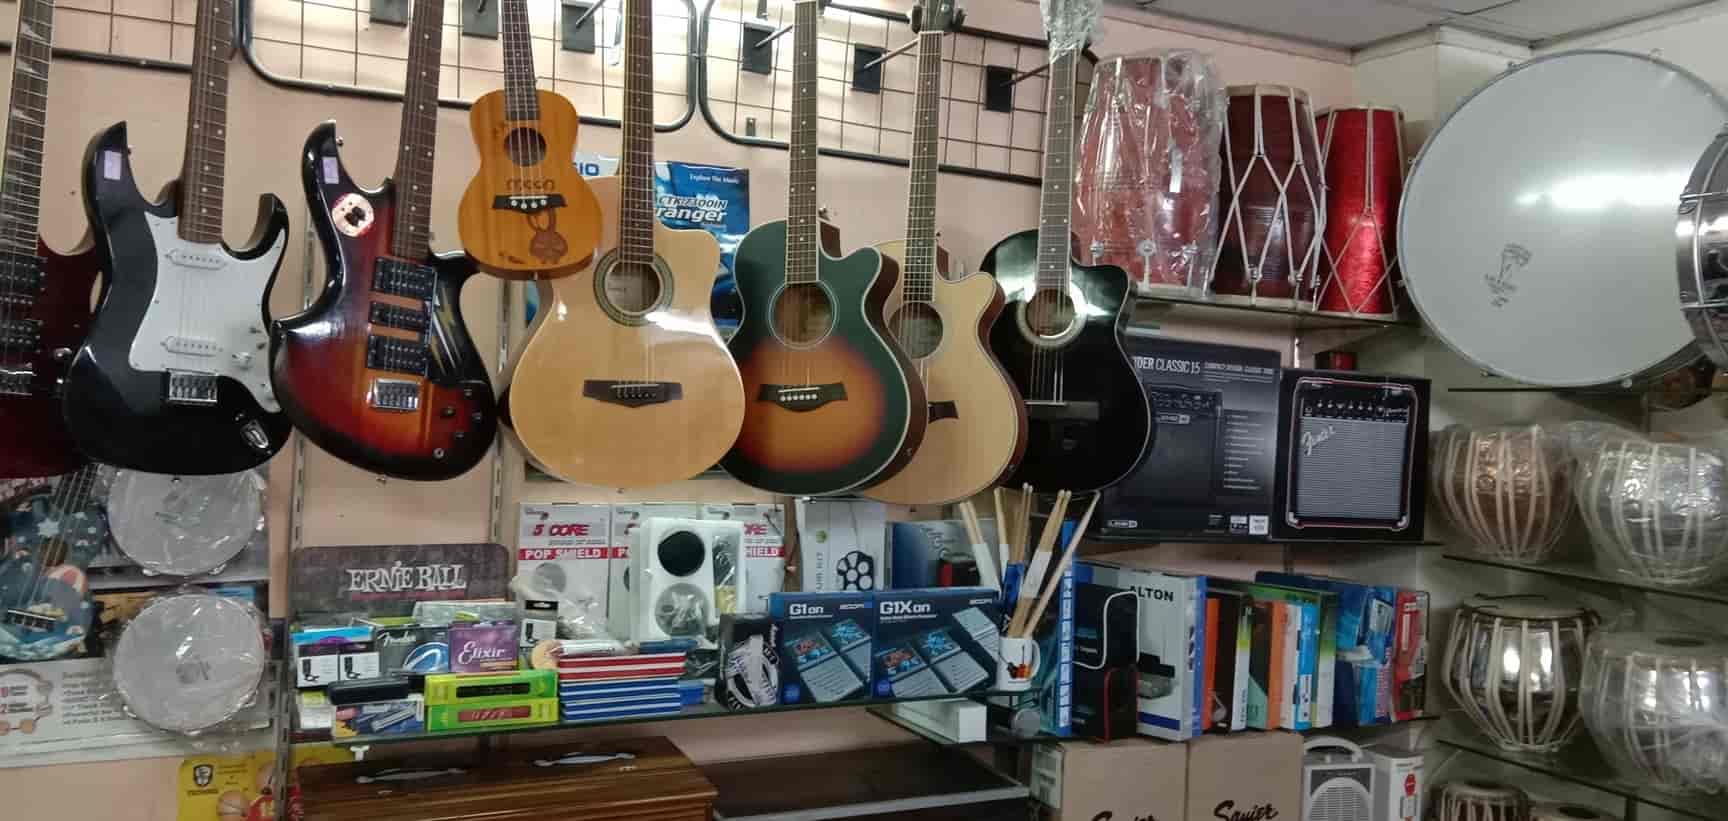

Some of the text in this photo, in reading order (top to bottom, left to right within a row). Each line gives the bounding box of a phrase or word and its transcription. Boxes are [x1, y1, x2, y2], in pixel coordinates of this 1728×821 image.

[1155, 358, 1191, 374] CLASSIC
[1191, 362, 1201, 374] 15
[533, 523, 591, 536] 5 CORE
[525, 549, 553, 560] POP
[345, 561, 467, 592] ERNIE BALL
[1129, 585, 1174, 602] ALTON
[458, 640, 505, 665] Elixir
